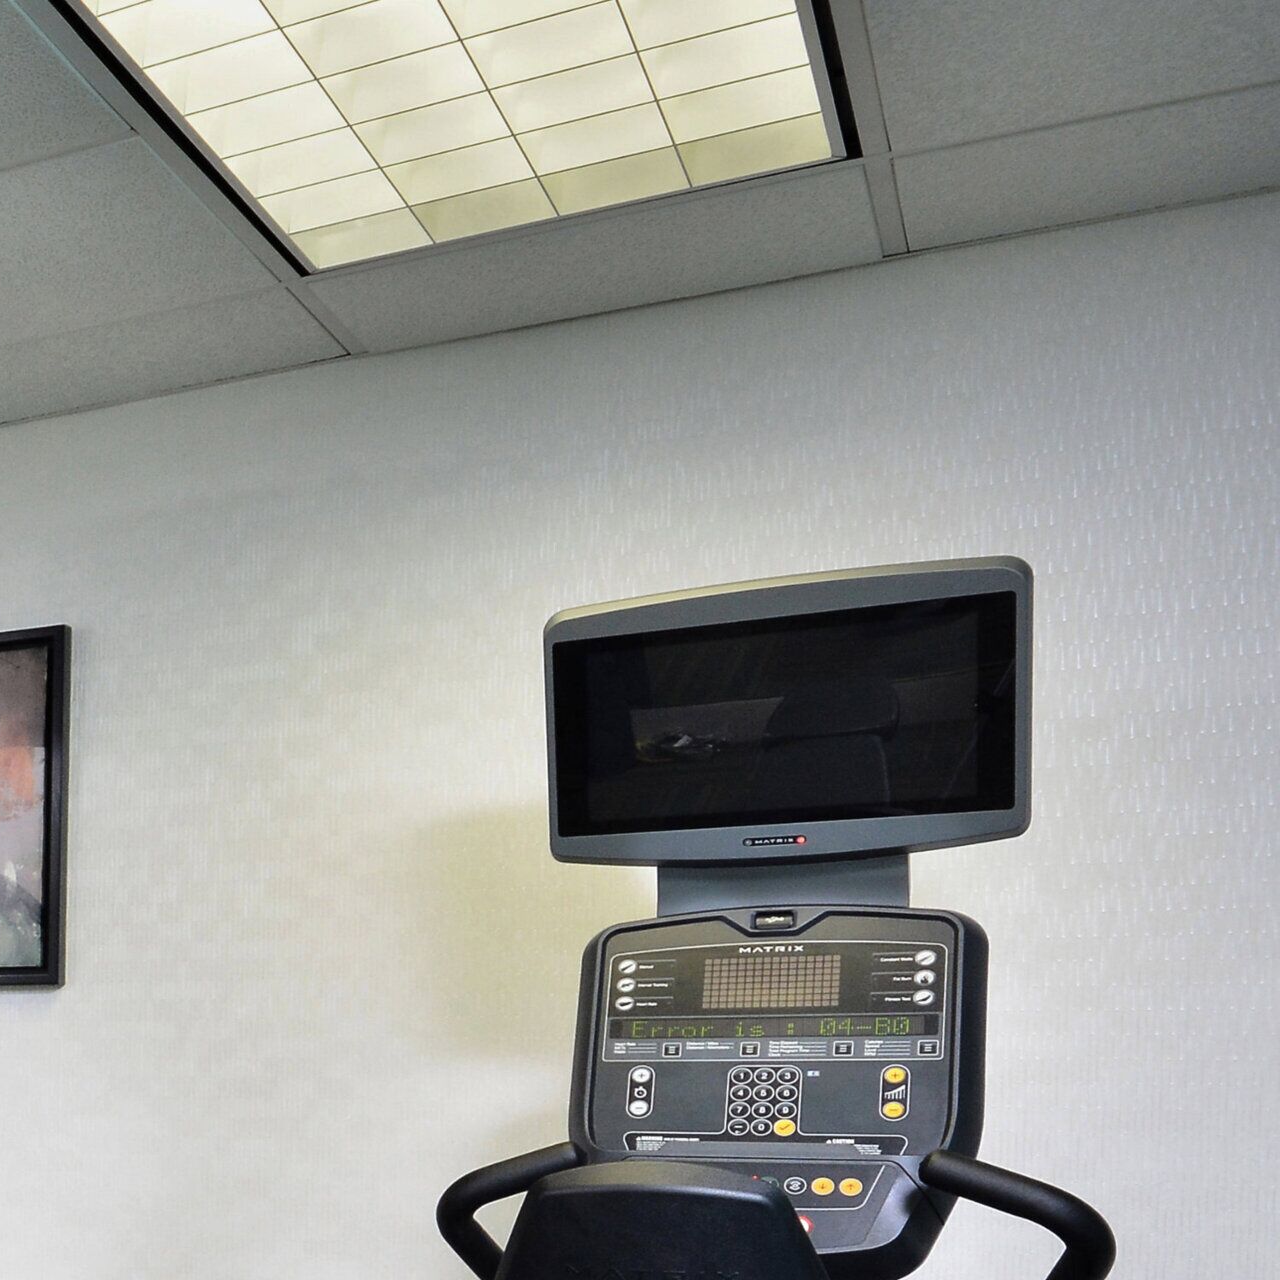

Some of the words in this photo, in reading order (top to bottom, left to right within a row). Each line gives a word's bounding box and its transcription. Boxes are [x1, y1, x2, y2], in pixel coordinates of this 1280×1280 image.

[739, 945, 804, 953] MATRIX
[632, 1020, 714, 1038] Error
[736, 1021, 765, 1037] is
